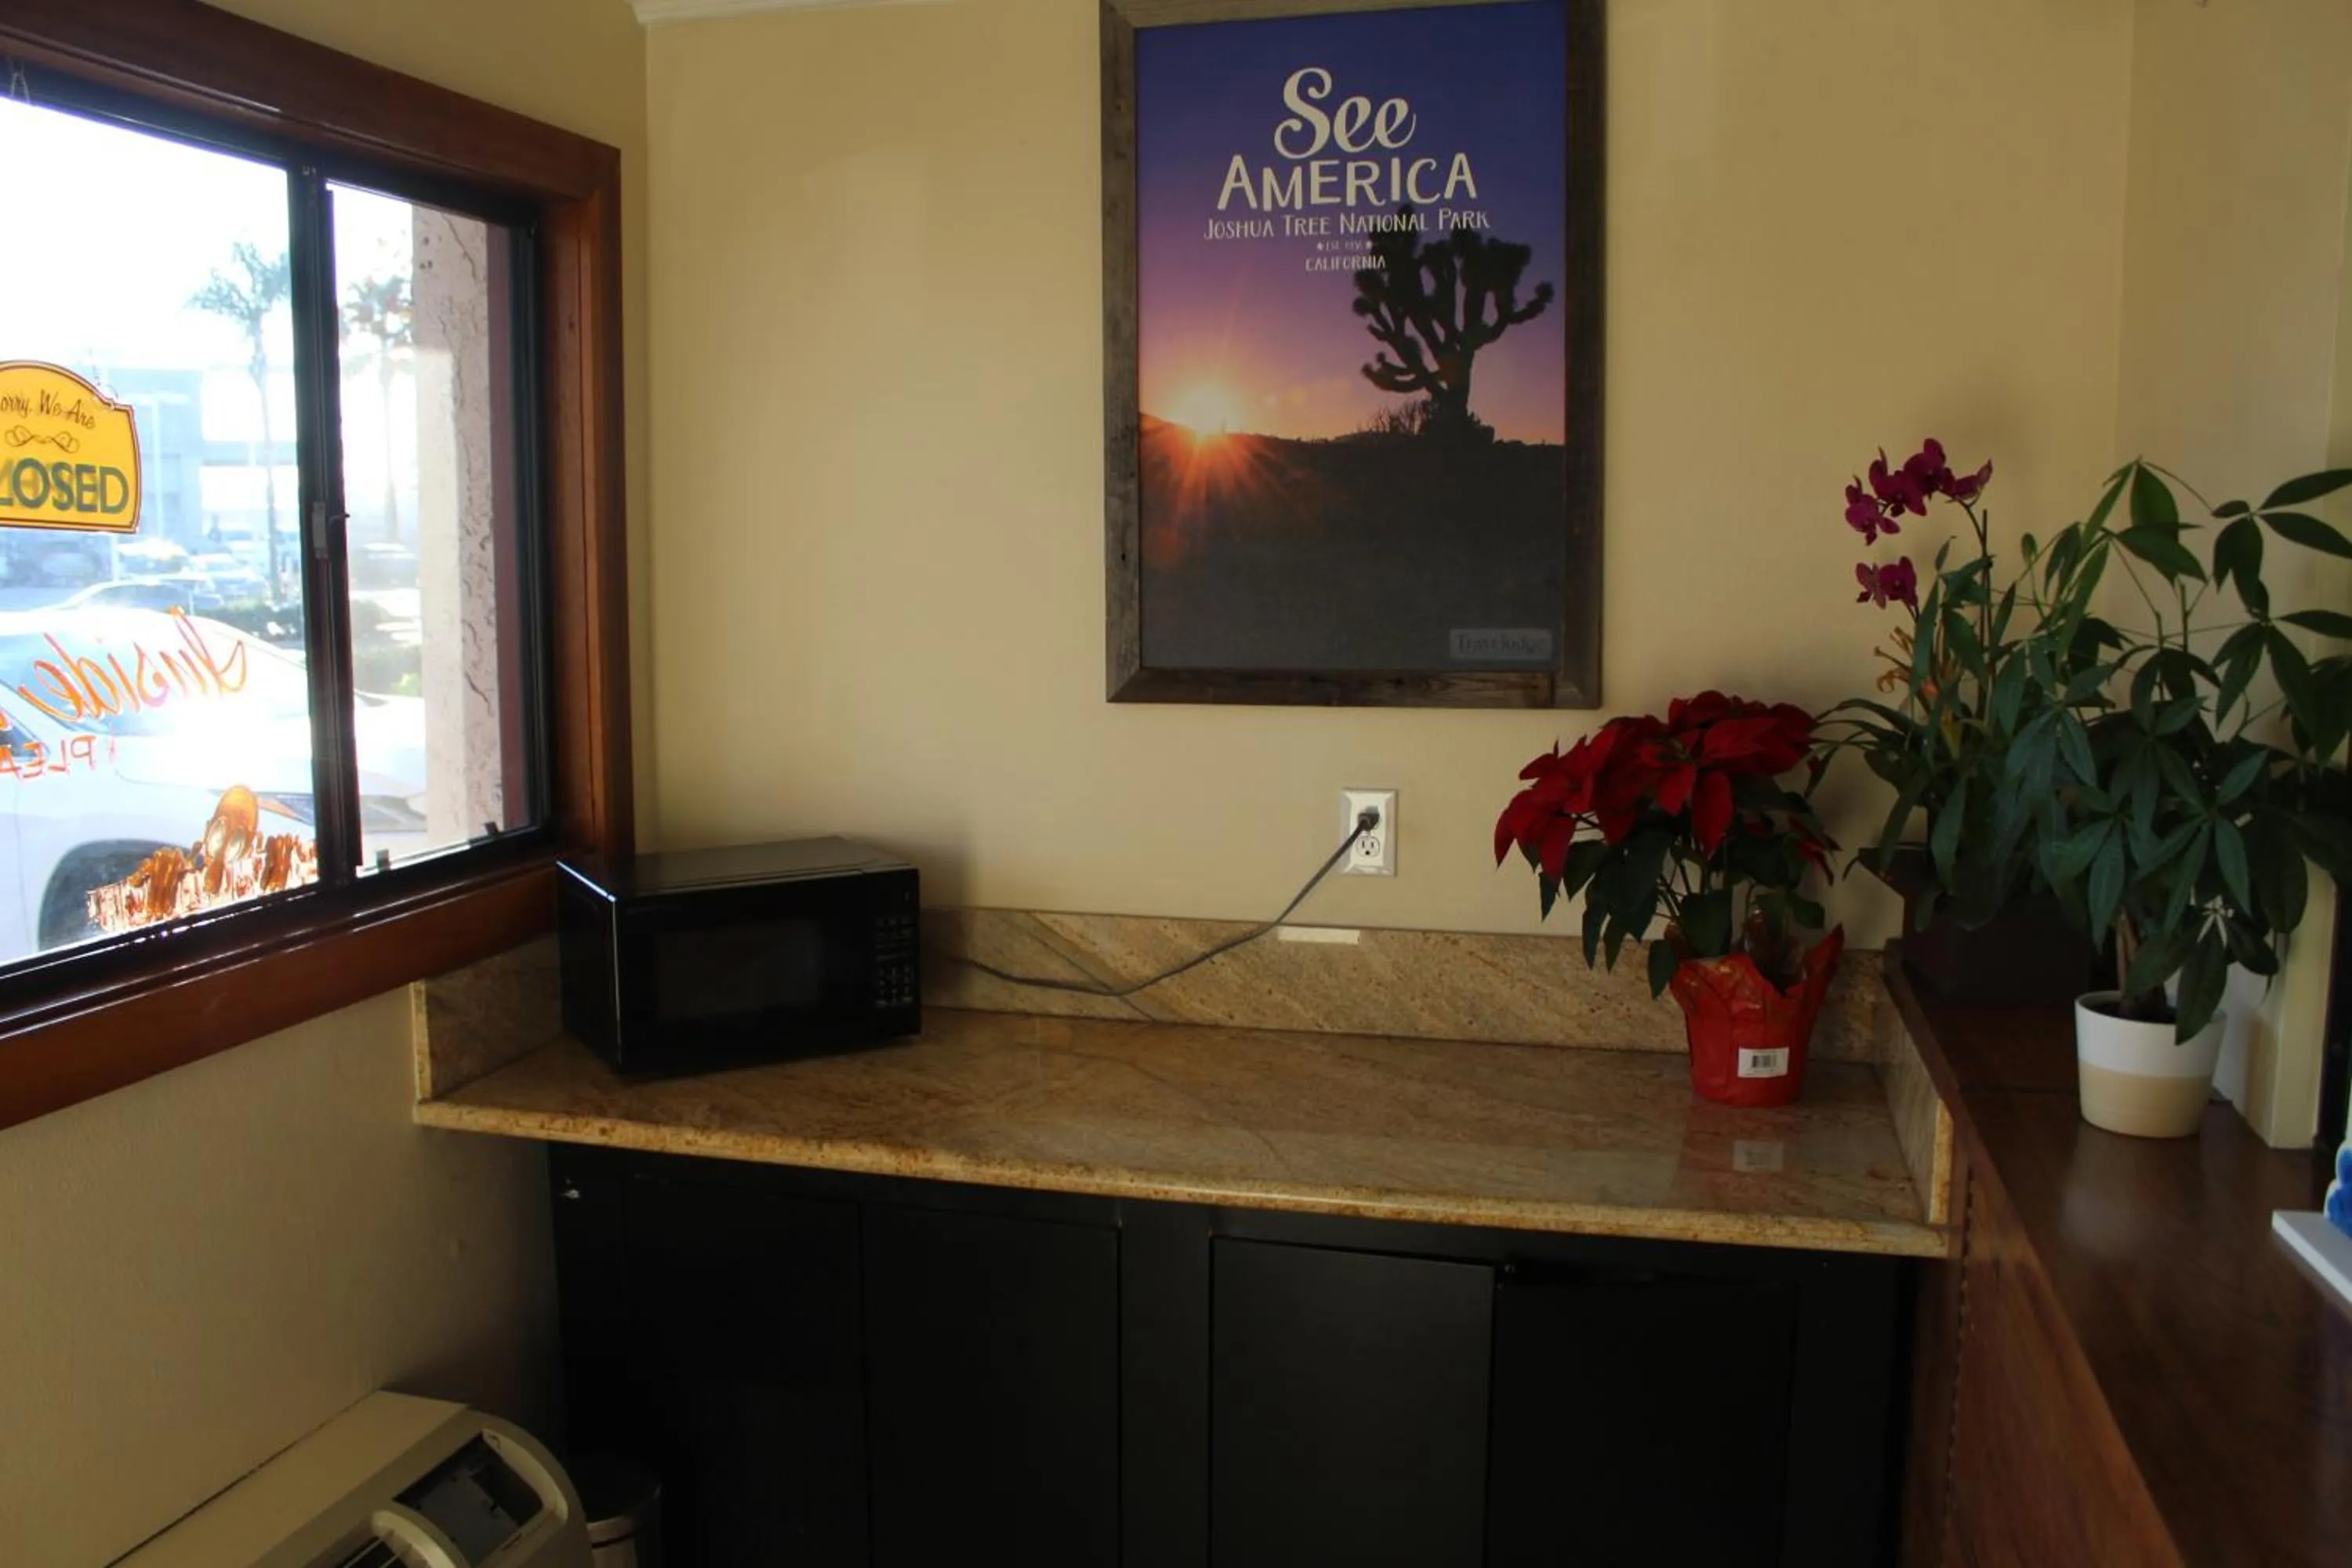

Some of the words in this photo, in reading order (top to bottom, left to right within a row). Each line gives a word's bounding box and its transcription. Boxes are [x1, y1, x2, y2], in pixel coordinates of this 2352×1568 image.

[1274, 67, 1417, 159] See
[1217, 153, 1477, 212] AMERICA
[1203, 217, 1274, 241] JOSHUA
[1283, 214, 1331, 236] TREE
[1339, 210, 1428, 234] NATIONAL
[1437, 207, 1490, 230] PARK
[1305, 255, 1386, 271] CALIFORNIA
[40, 389, 63, 416] We
[65, 398, 96, 429] Are
